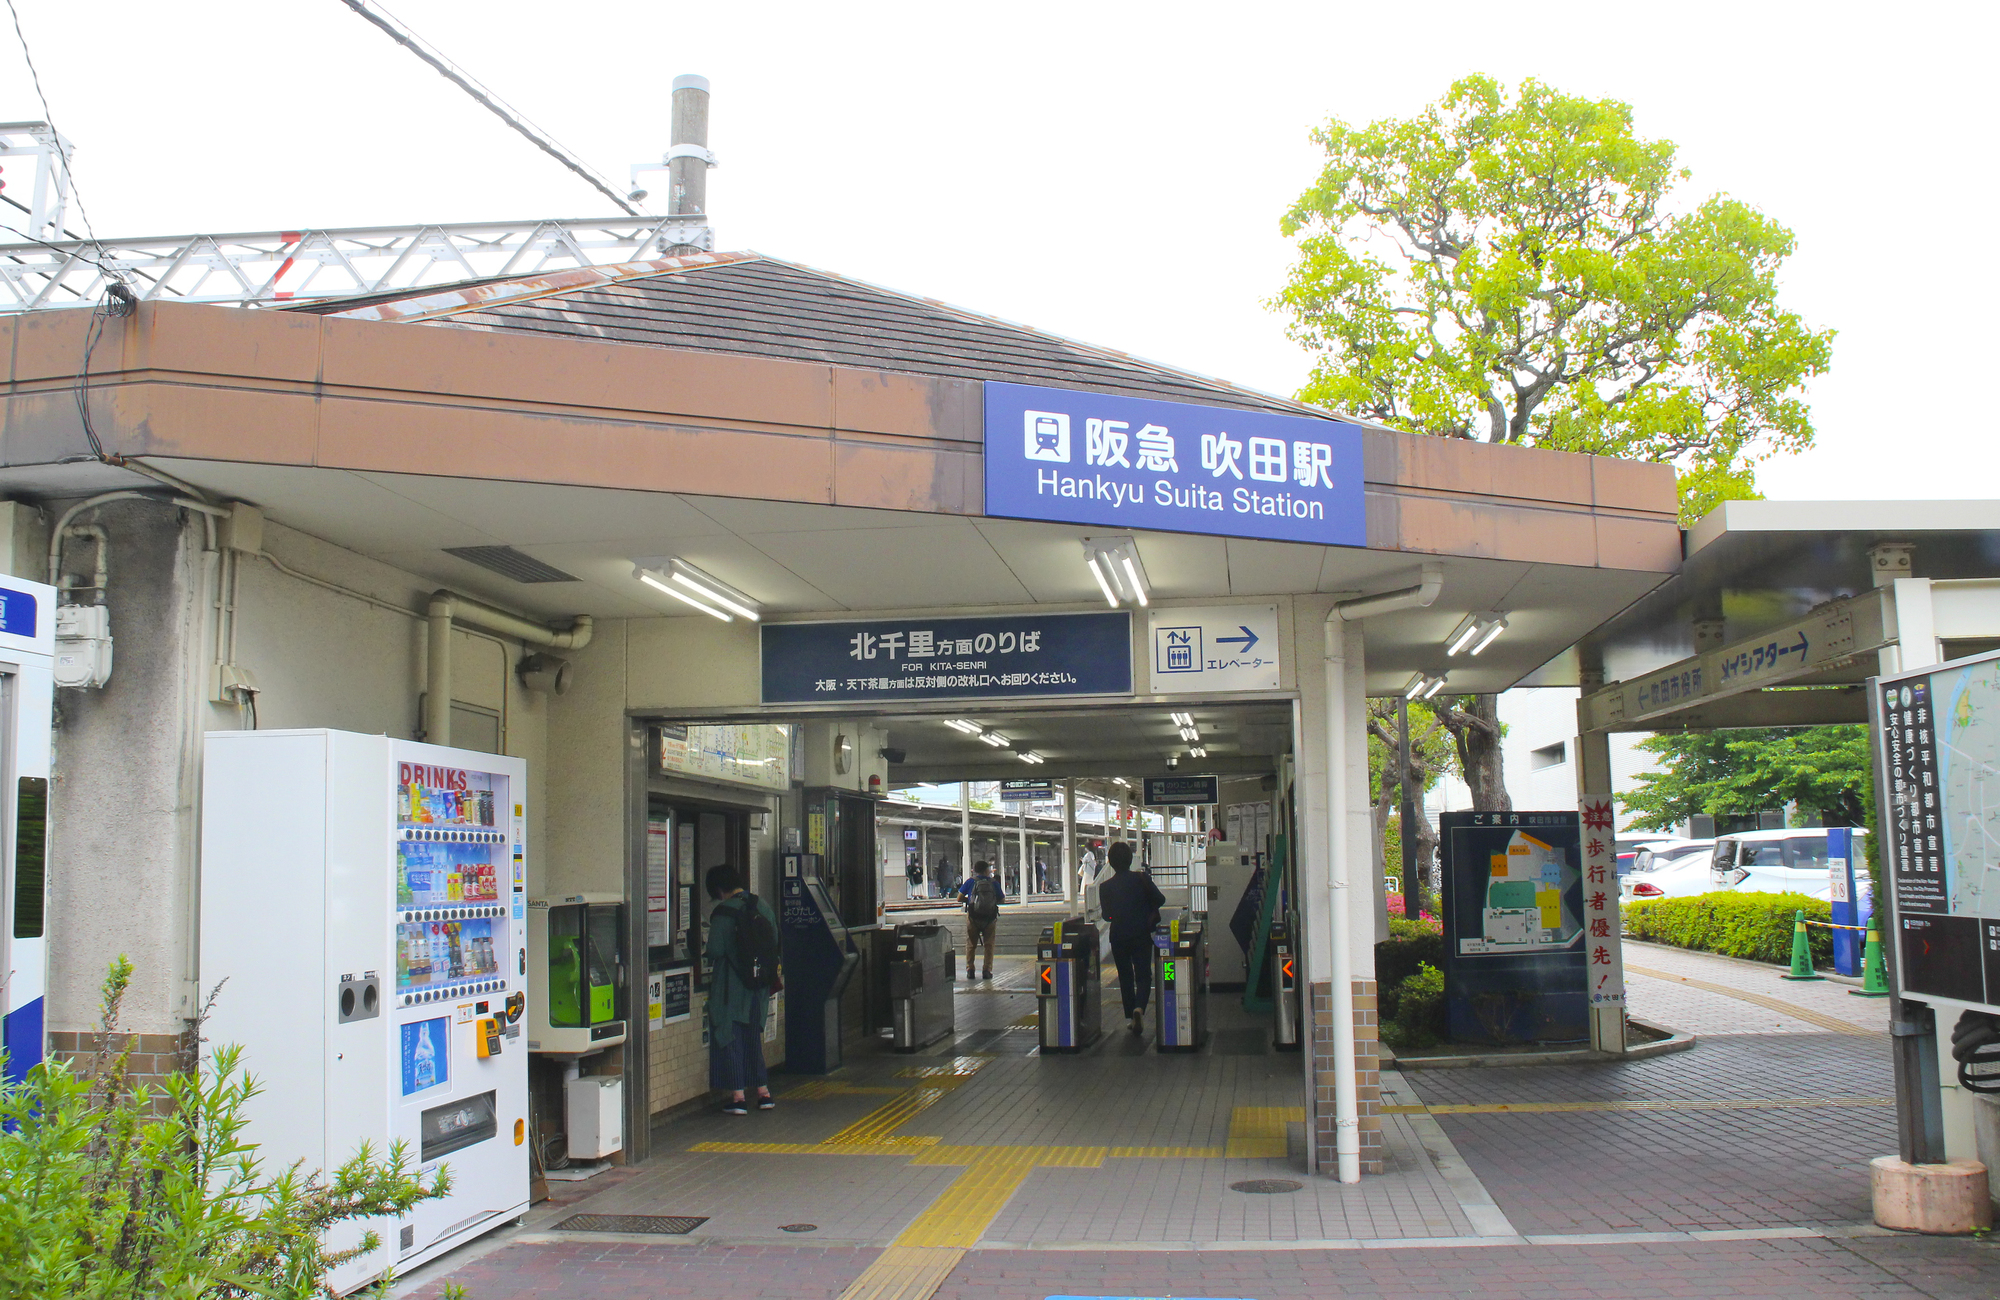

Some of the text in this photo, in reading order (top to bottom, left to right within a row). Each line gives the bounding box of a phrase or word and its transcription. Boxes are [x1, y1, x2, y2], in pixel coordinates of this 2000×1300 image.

[1085, 417, 1334, 490] 阪急 吹田駅
[1037, 468, 1324, 520] Hankyu Suita Station
[850, 631, 1041, 661] 北千里方面のりば
[901, 661, 987, 672] FOR KITA-SENRI
[1207, 658, 1274, 670] エレベーター
[1720, 642, 1790, 684] メイシアター
[401, 763, 467, 791] DRINKS
[1903, 710, 1924, 872] 健康づくり都市宣言
[1917, 708, 1938, 872] 非核平和都市宣言
[1474, 814, 1519, 825] ご案内
[788, 859, 794, 874] 1
[1164, 962, 1175, 972] IC
